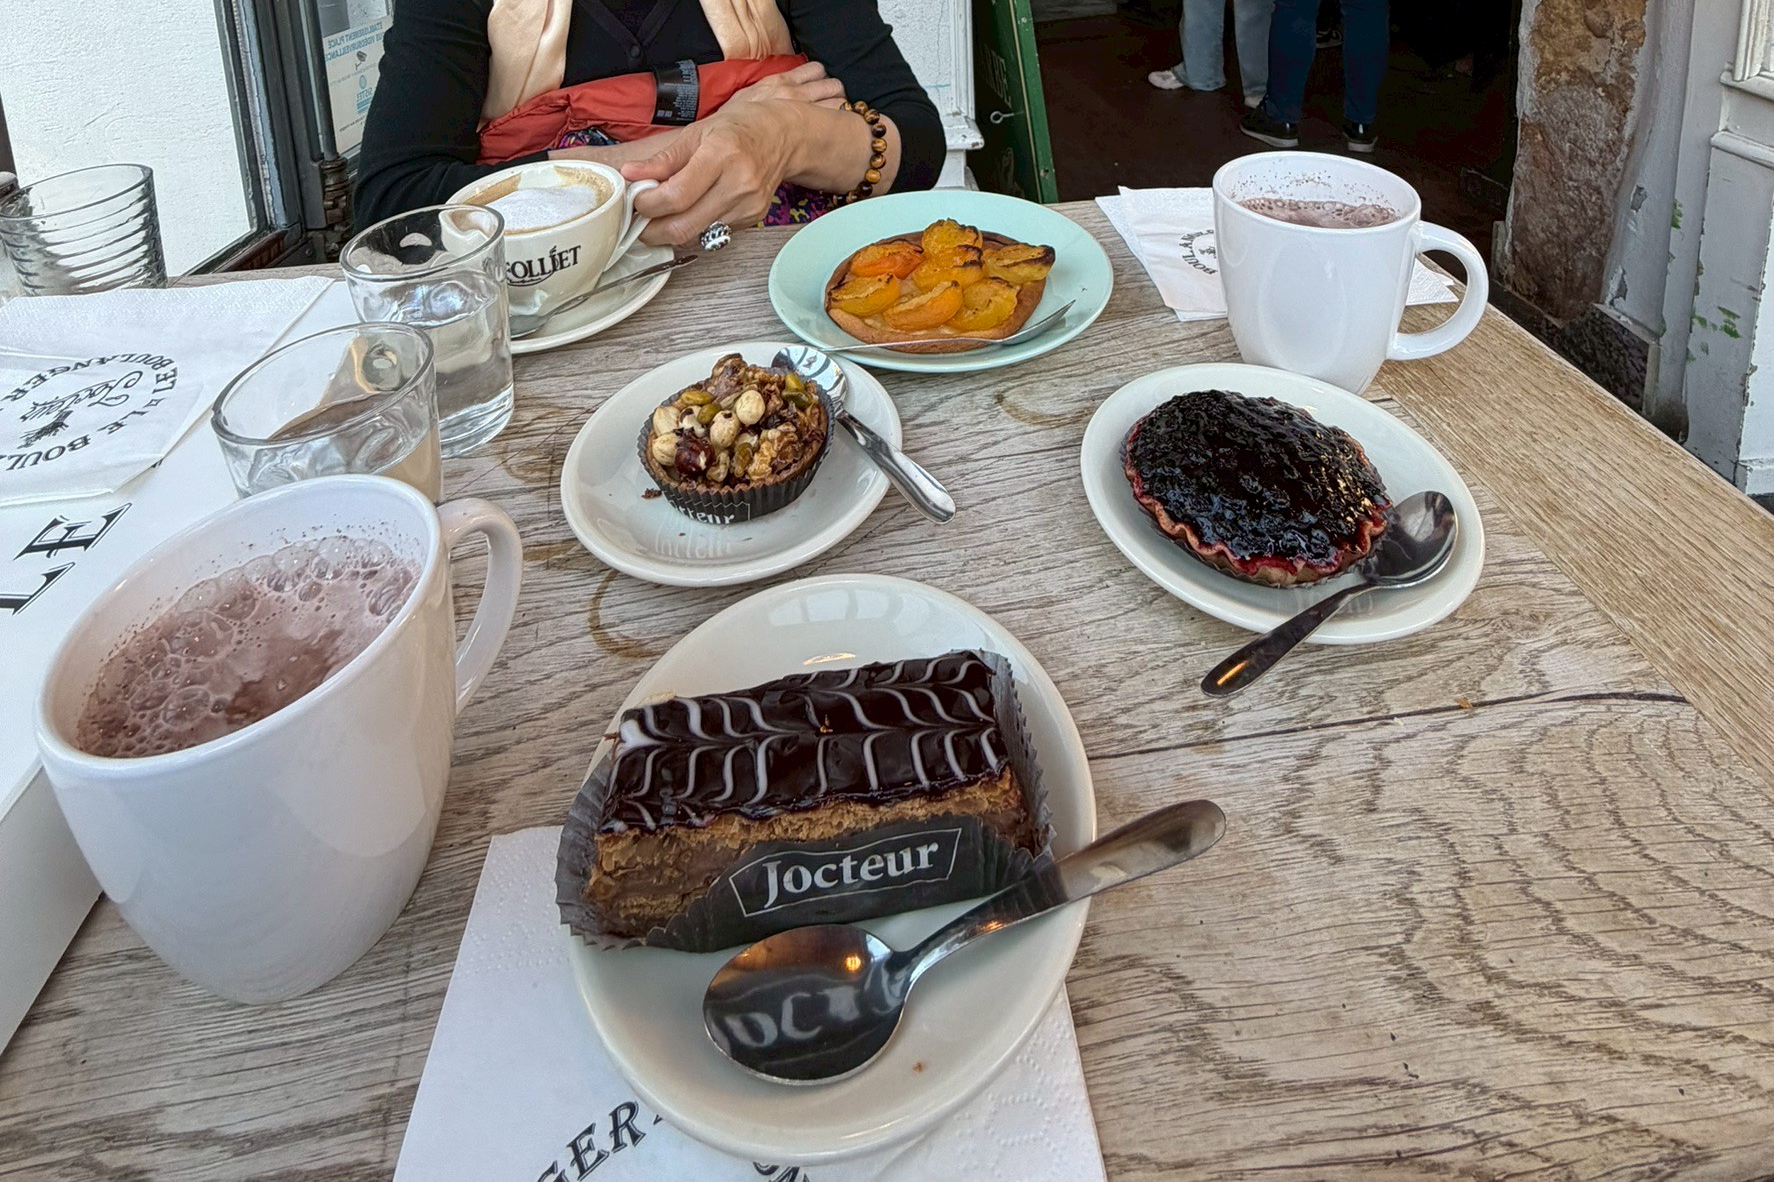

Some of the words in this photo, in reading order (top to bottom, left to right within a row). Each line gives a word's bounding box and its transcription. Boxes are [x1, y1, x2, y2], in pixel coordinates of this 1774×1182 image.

[506, 243, 581, 280] OLLIET
[0, 434, 91, 471] BOUL
[763, 842, 939, 908] Jocteur
